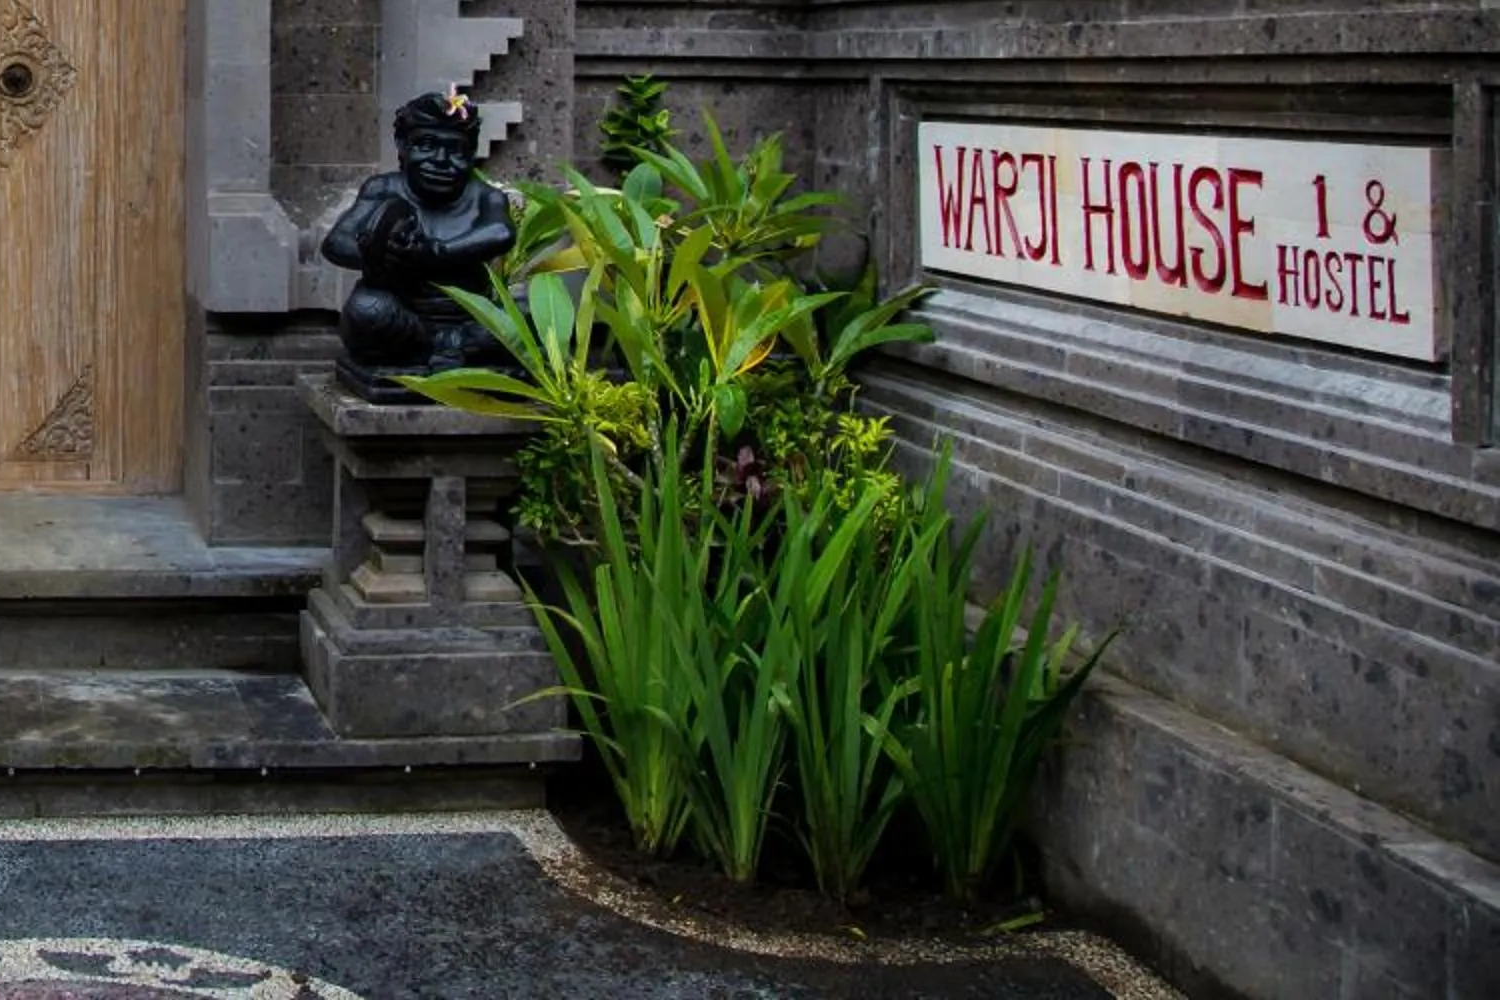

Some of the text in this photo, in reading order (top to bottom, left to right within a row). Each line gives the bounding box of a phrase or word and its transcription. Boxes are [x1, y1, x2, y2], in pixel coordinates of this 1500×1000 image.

[933, 145, 1400, 300] WARJI HOUSE 1 &
[1276, 244, 1411, 325] HOSTEL
